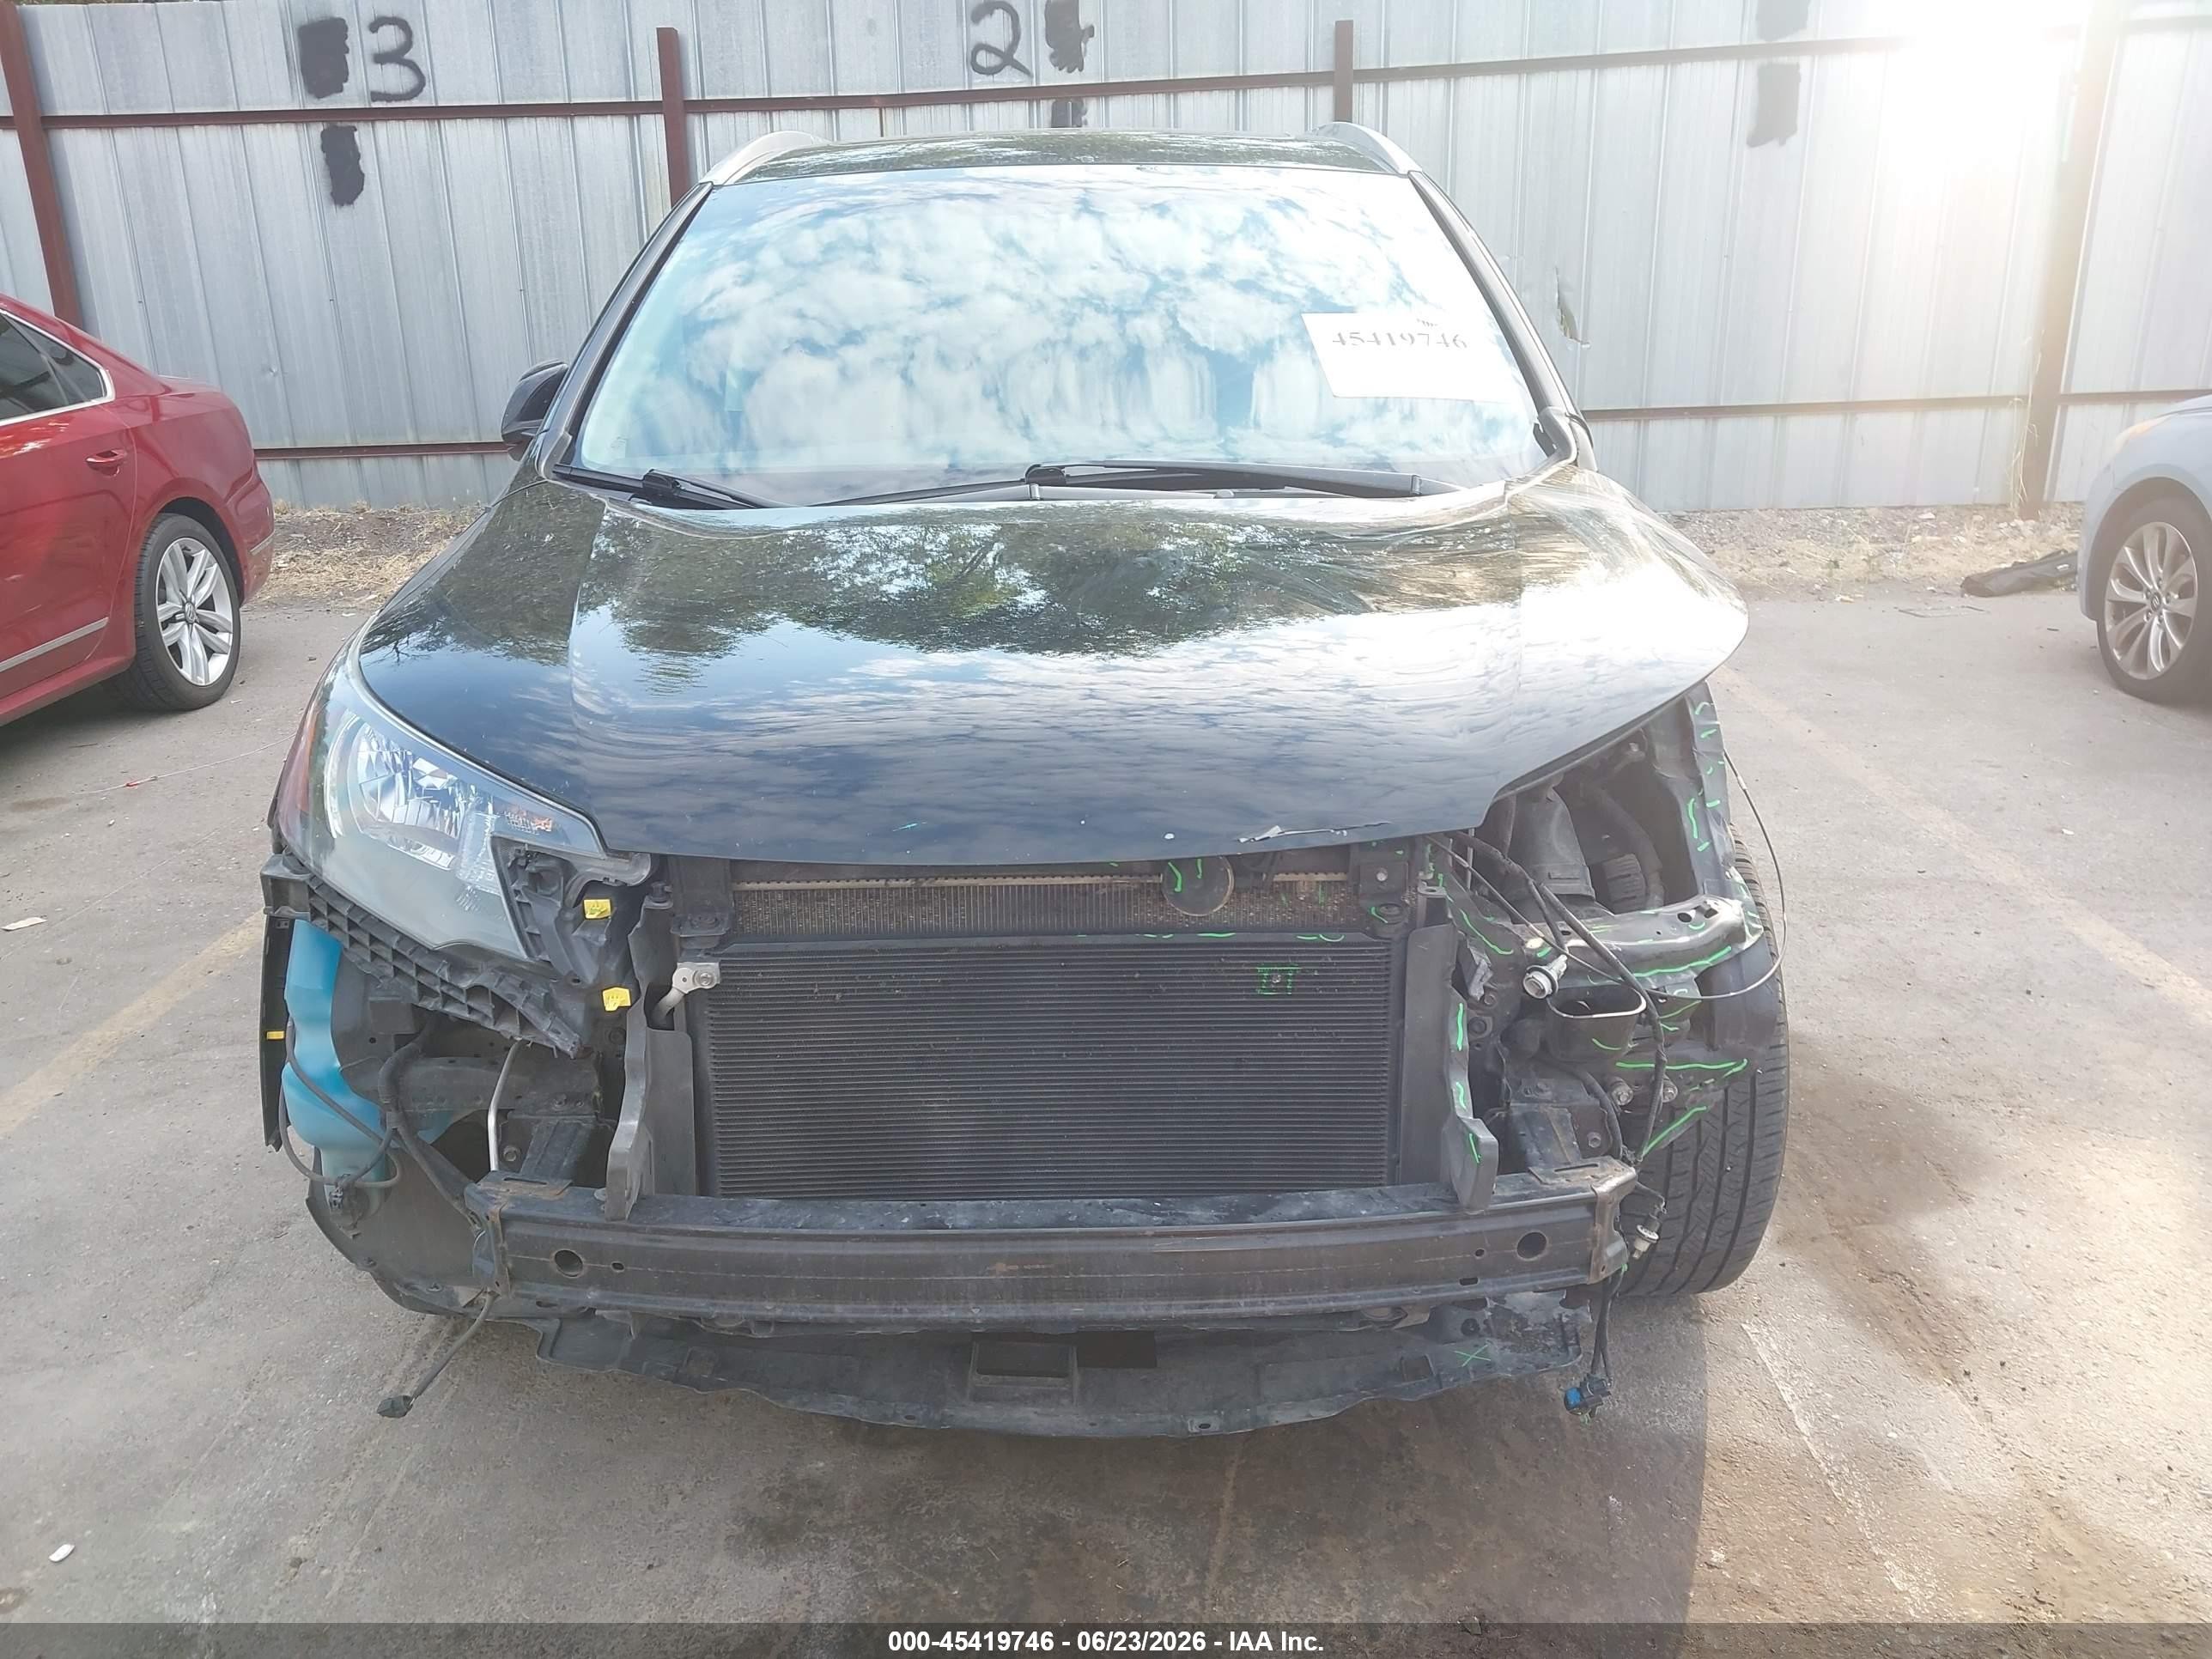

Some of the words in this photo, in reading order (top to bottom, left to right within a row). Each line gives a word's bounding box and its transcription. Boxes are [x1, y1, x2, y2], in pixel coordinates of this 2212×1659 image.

[368, 15, 427, 103] 3
[970, 0, 1034, 78] 2
[1332, 331, 1468, 349] 45419746
